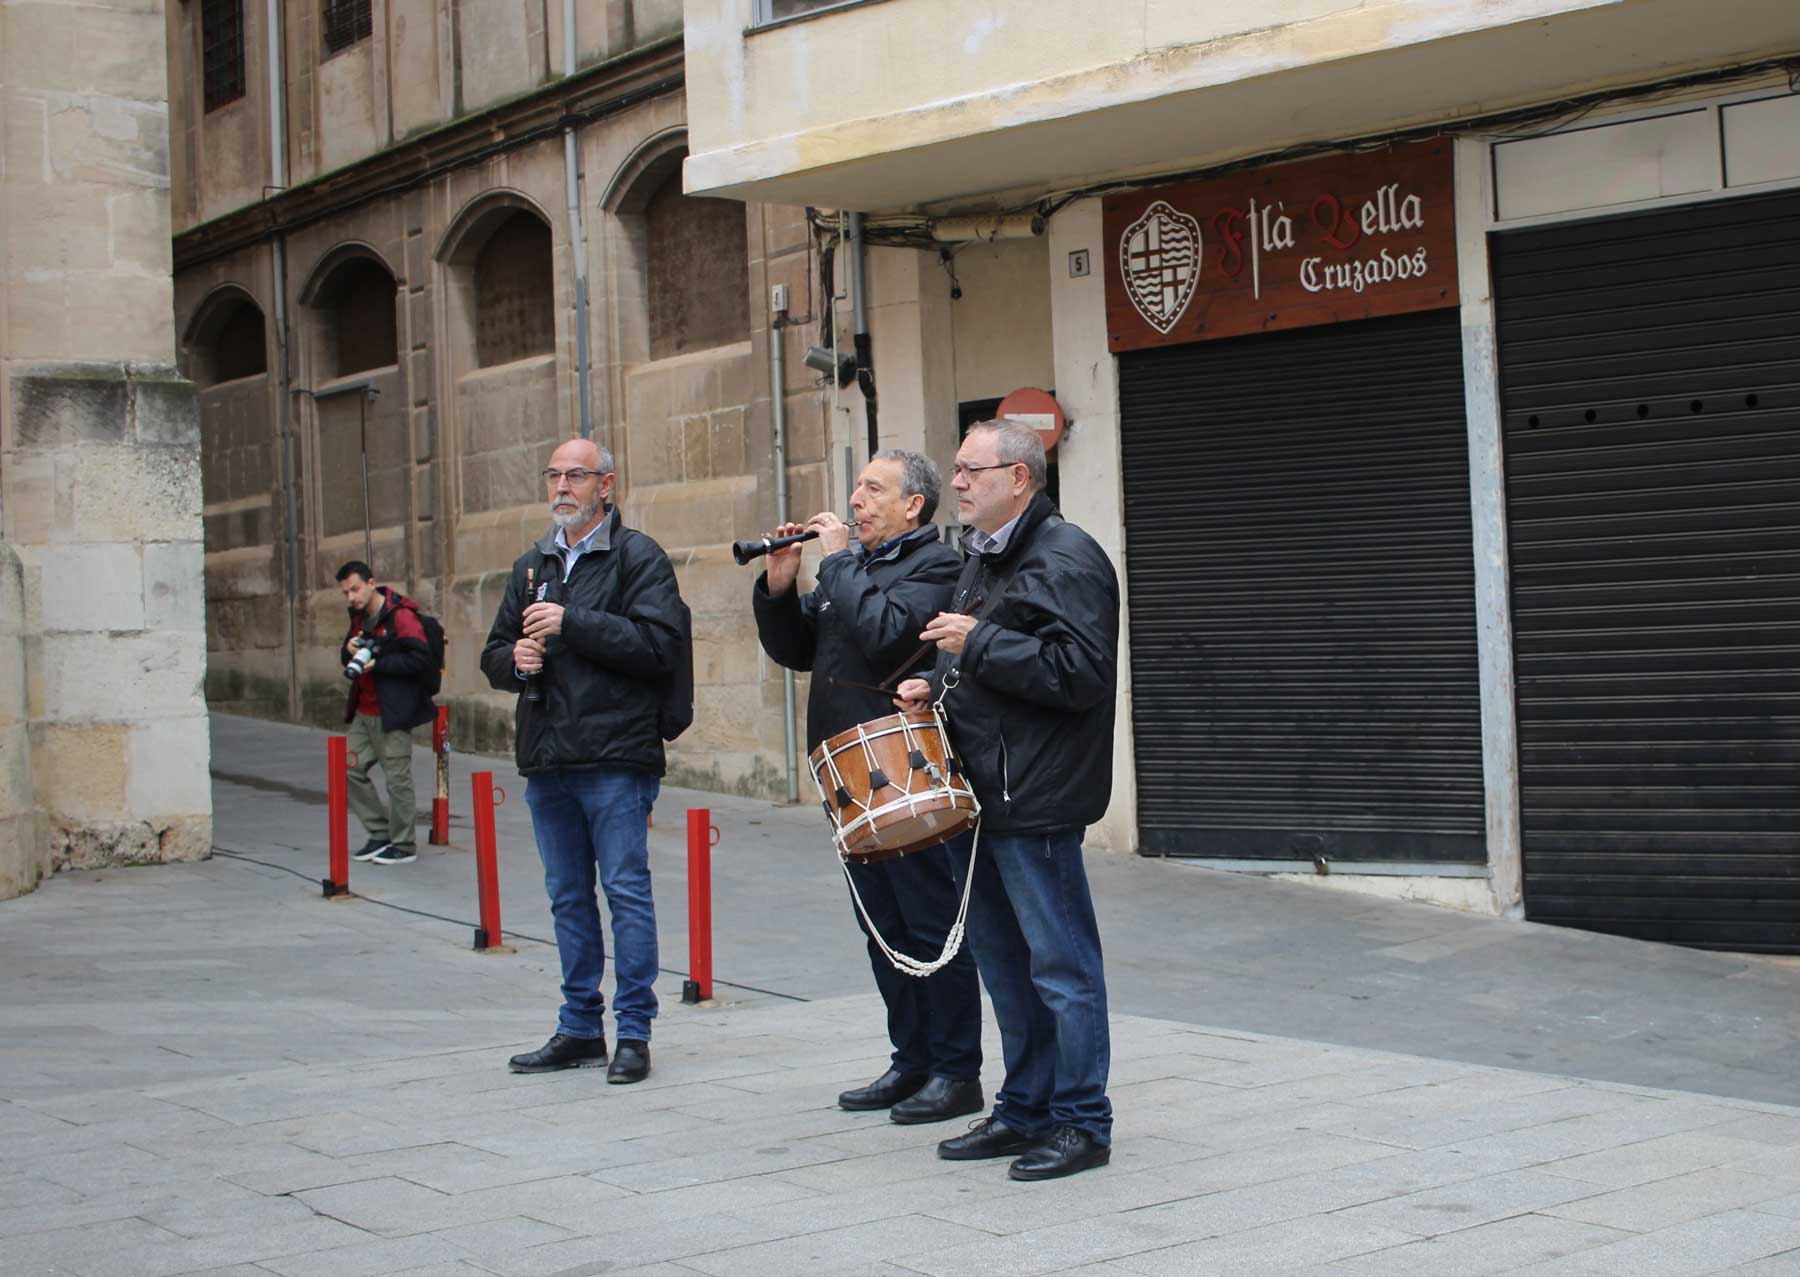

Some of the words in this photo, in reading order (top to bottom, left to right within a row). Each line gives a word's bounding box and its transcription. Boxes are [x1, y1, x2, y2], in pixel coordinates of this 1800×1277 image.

[1312, 183, 1424, 249] Vella
[1075, 256, 1083, 272] 5
[1300, 247, 1426, 292] Cruzados
